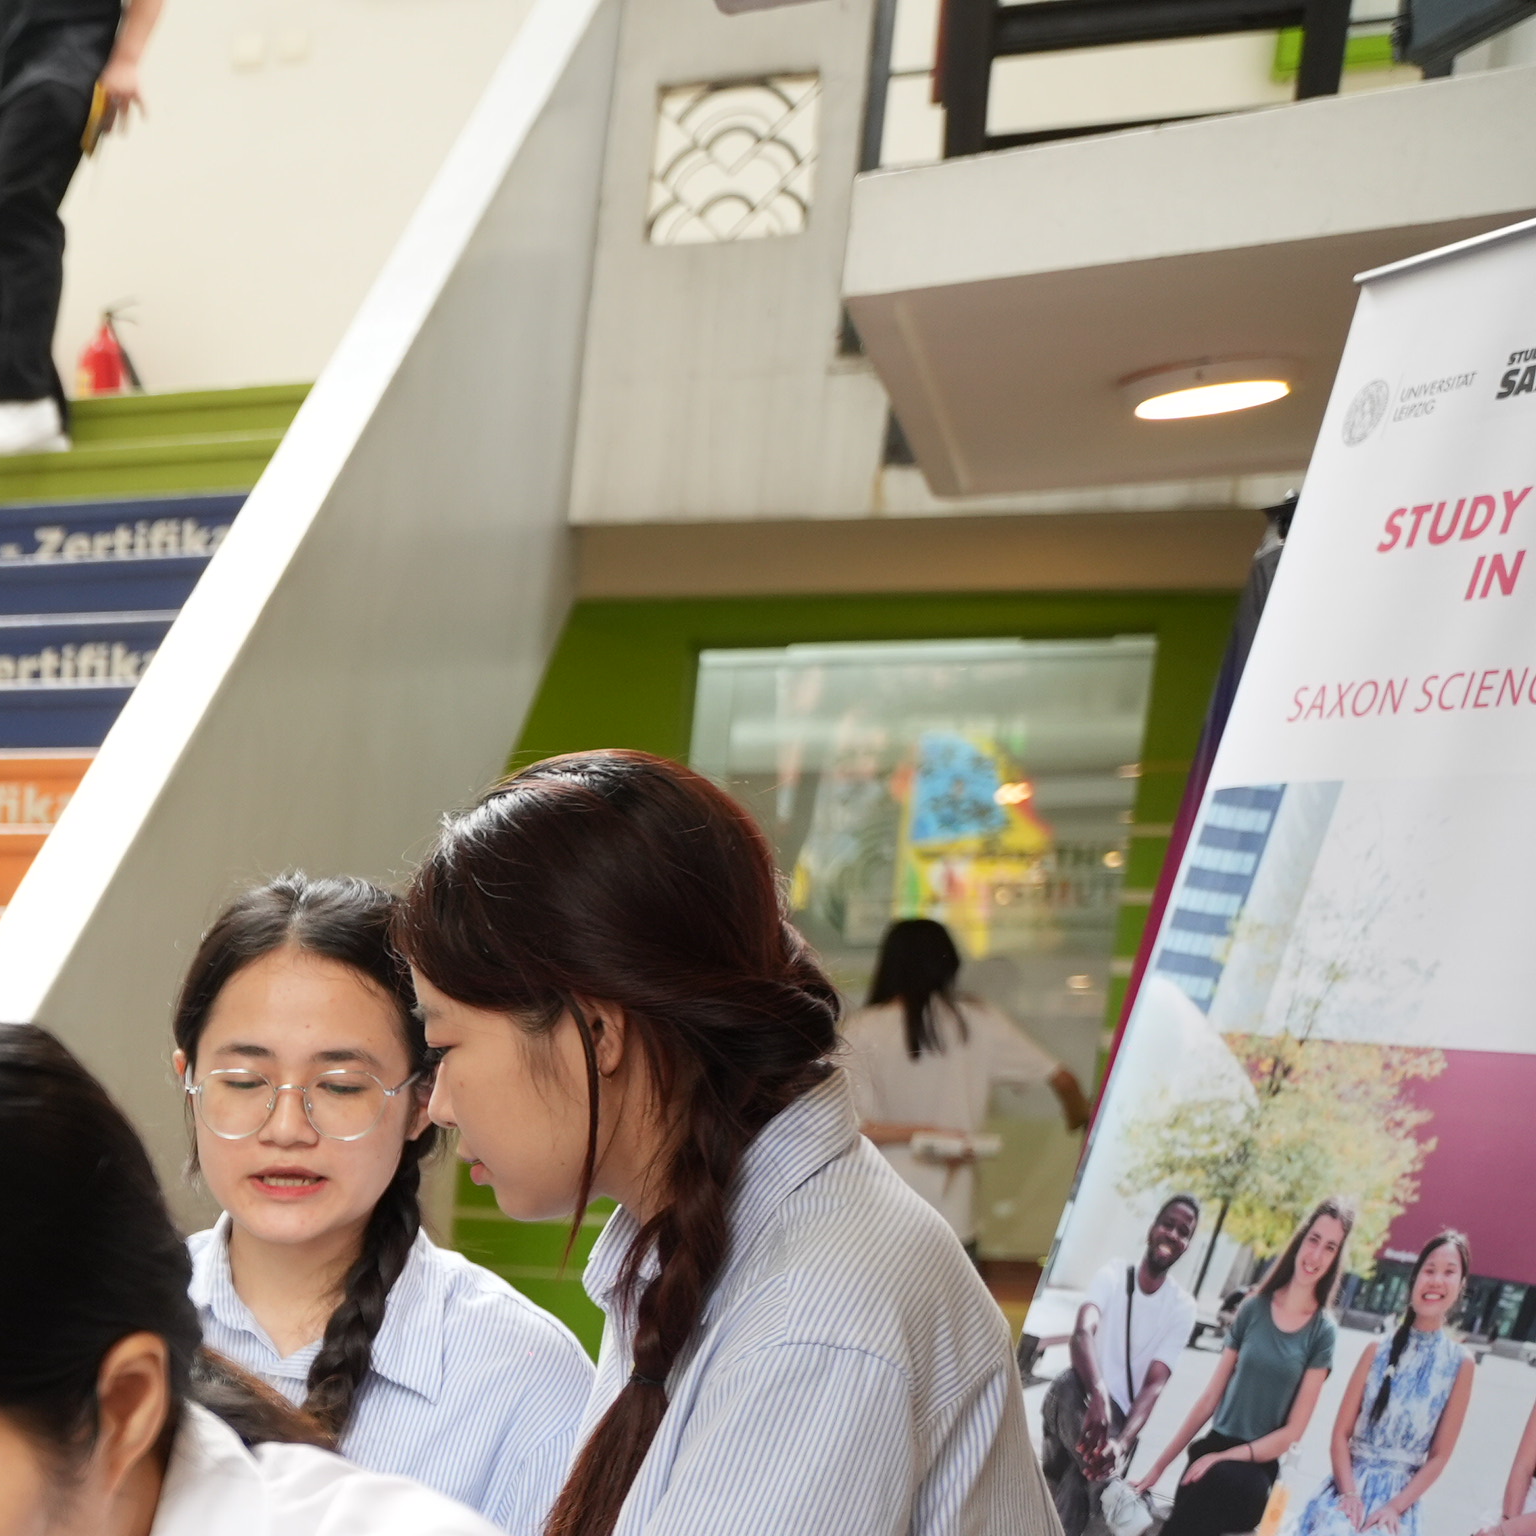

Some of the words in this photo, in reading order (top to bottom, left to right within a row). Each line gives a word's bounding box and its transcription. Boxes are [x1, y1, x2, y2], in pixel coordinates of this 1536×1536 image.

[1495, 365, 1536, 400] SA
[1393, 399, 1436, 422] LEIPZIG
[1377, 486, 1533, 553] STUDY
[1464, 549, 1526, 601] IN
[1286, 677, 1408, 723] SAXON
